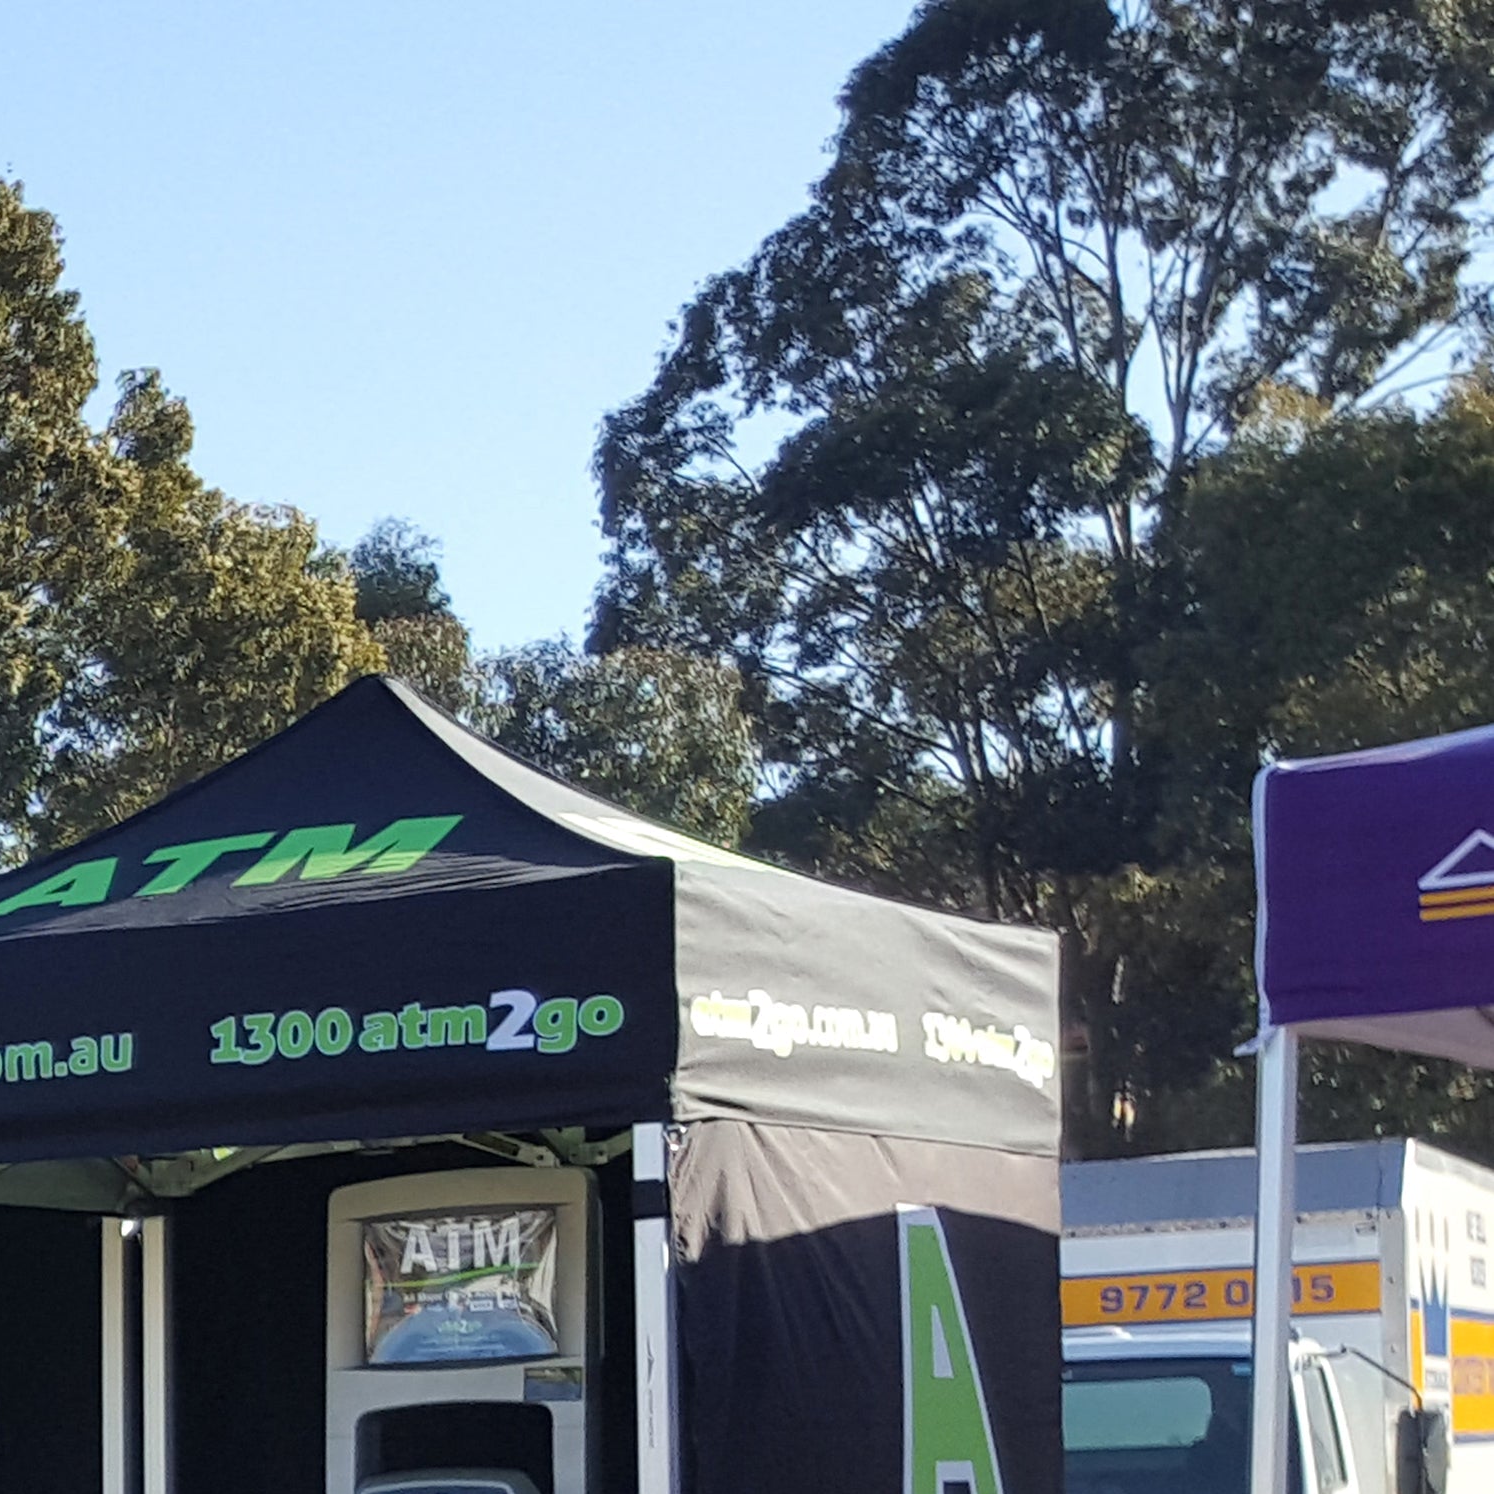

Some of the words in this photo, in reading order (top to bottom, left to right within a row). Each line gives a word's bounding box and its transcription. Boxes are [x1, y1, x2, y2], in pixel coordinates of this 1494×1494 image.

[400, 1217, 522, 1275] ATM
[1099, 1280, 1207, 1314] 9772
[1223, 1274, 1335, 1308] 015
